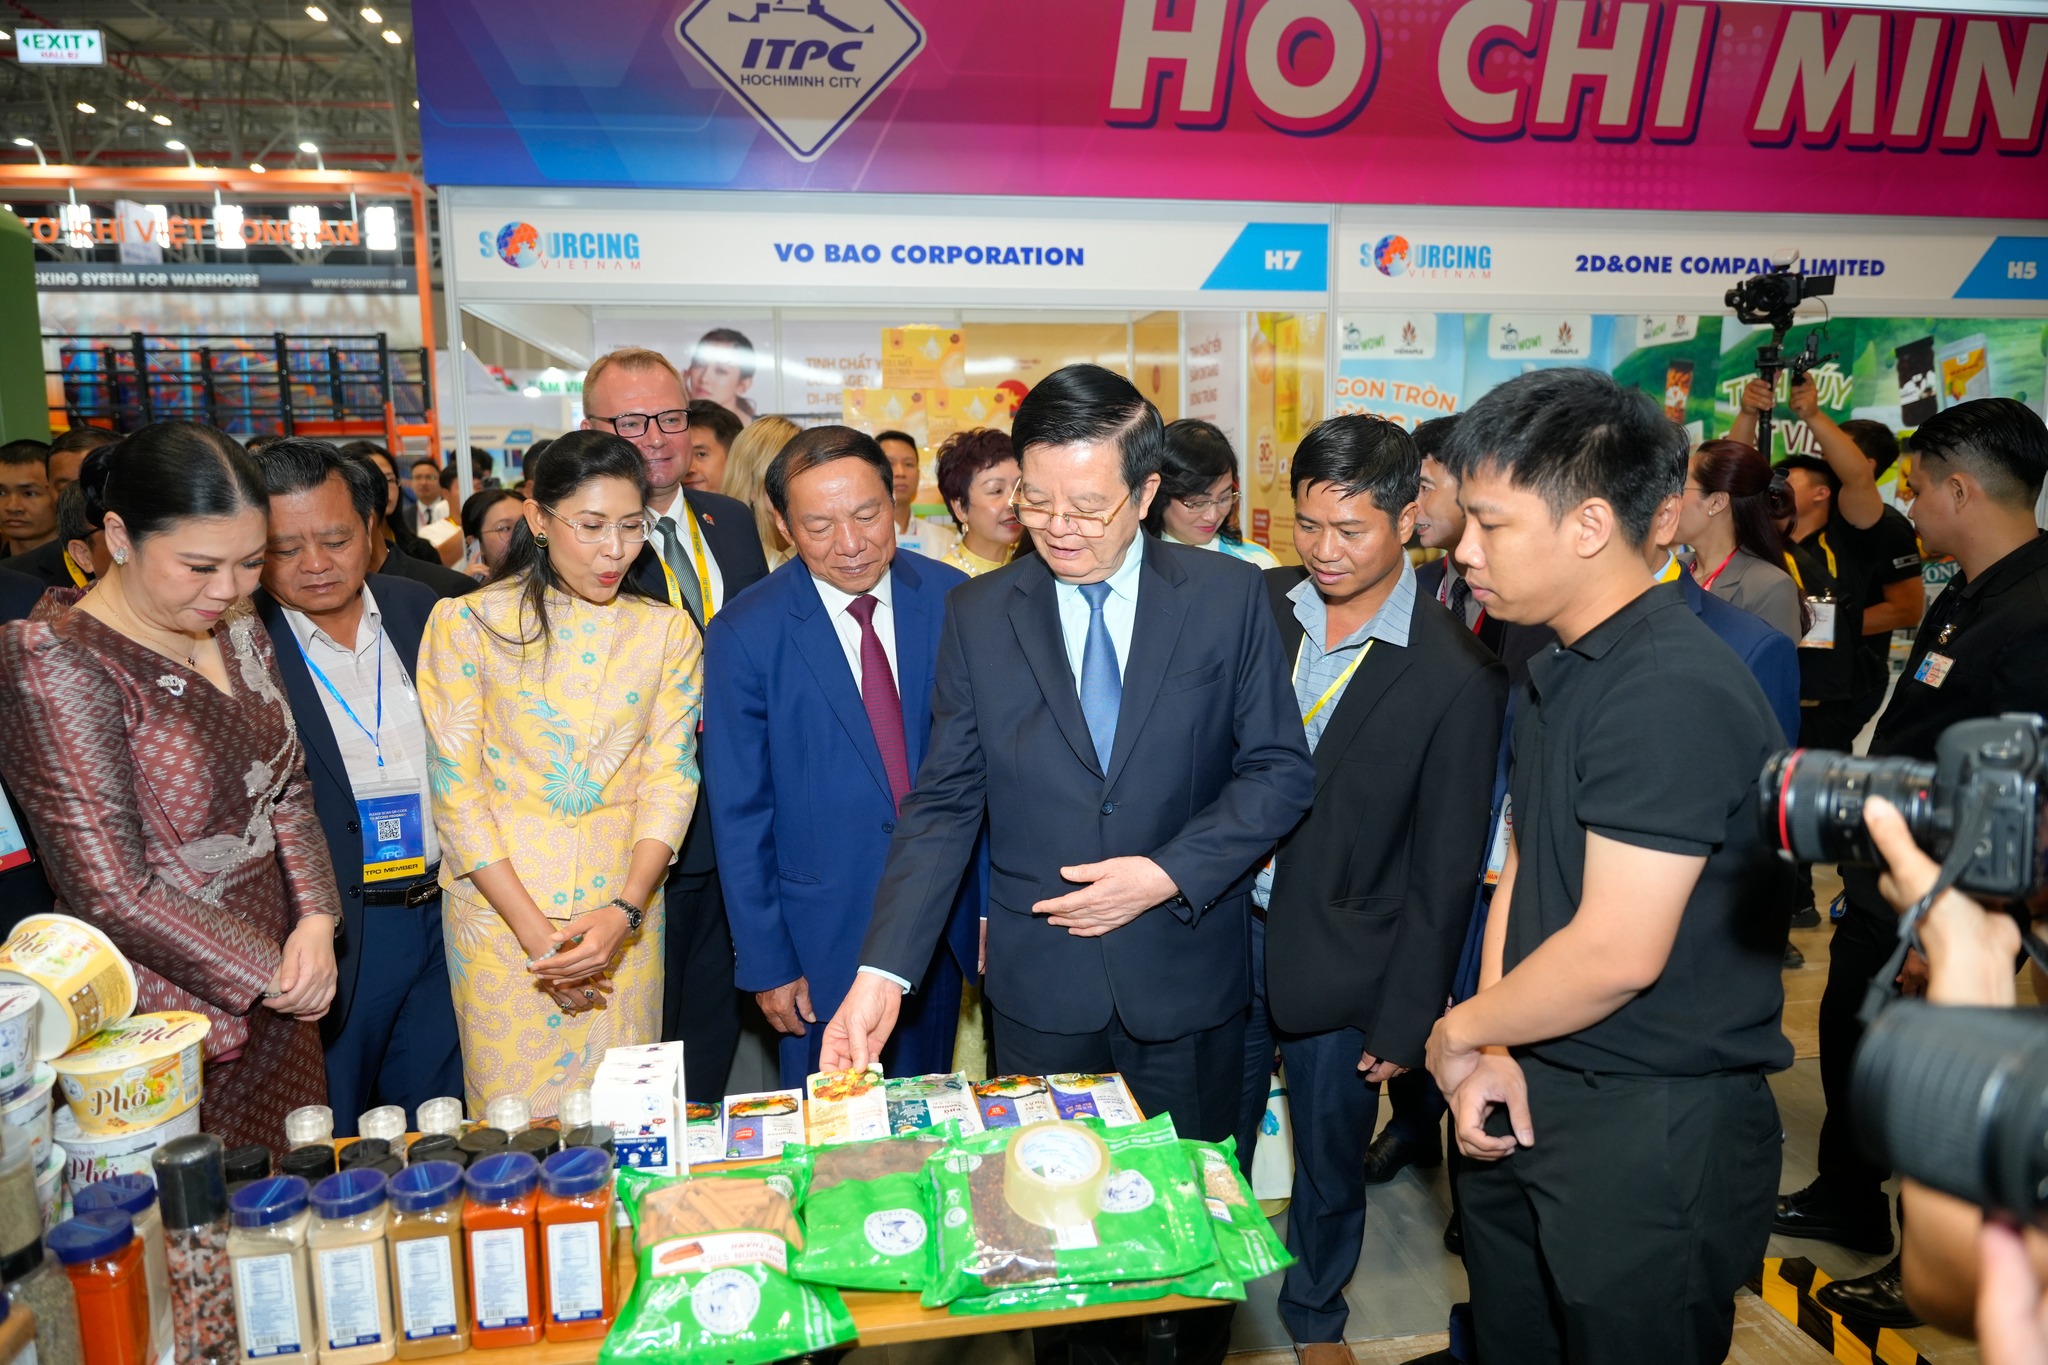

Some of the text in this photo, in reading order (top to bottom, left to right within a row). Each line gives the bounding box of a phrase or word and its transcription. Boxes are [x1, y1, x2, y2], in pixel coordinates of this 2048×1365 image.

[33, 34, 83, 49] EXIT
[741, 38, 864, 72] ITPC
[1108, 0, 2048, 141] HO CHI MIN
[740, 74, 863, 89] HOCHIMINH CITY
[540, 259, 642, 271] VIETNAM
[773, 242, 1084, 267] VO BAO CORPORATION
[1264, 250, 1302, 271] H7
[1408, 268, 1492, 279] VIETNAM
[1575, 255, 1885, 277] 2D&ONE COMPAN LIMITED
[2006, 261, 2038, 280] H5
[80, 272, 136, 287] SYSTEM
[138, 273, 169, 287] FOR
[170, 273, 260, 288] WAREHOUSE
[1391, 383, 1457, 413] TRÒN
[383, 863, 419, 873] MEMBER
[86, 1079, 149, 1117] Phở
[68, 1156, 120, 1184] Phở
